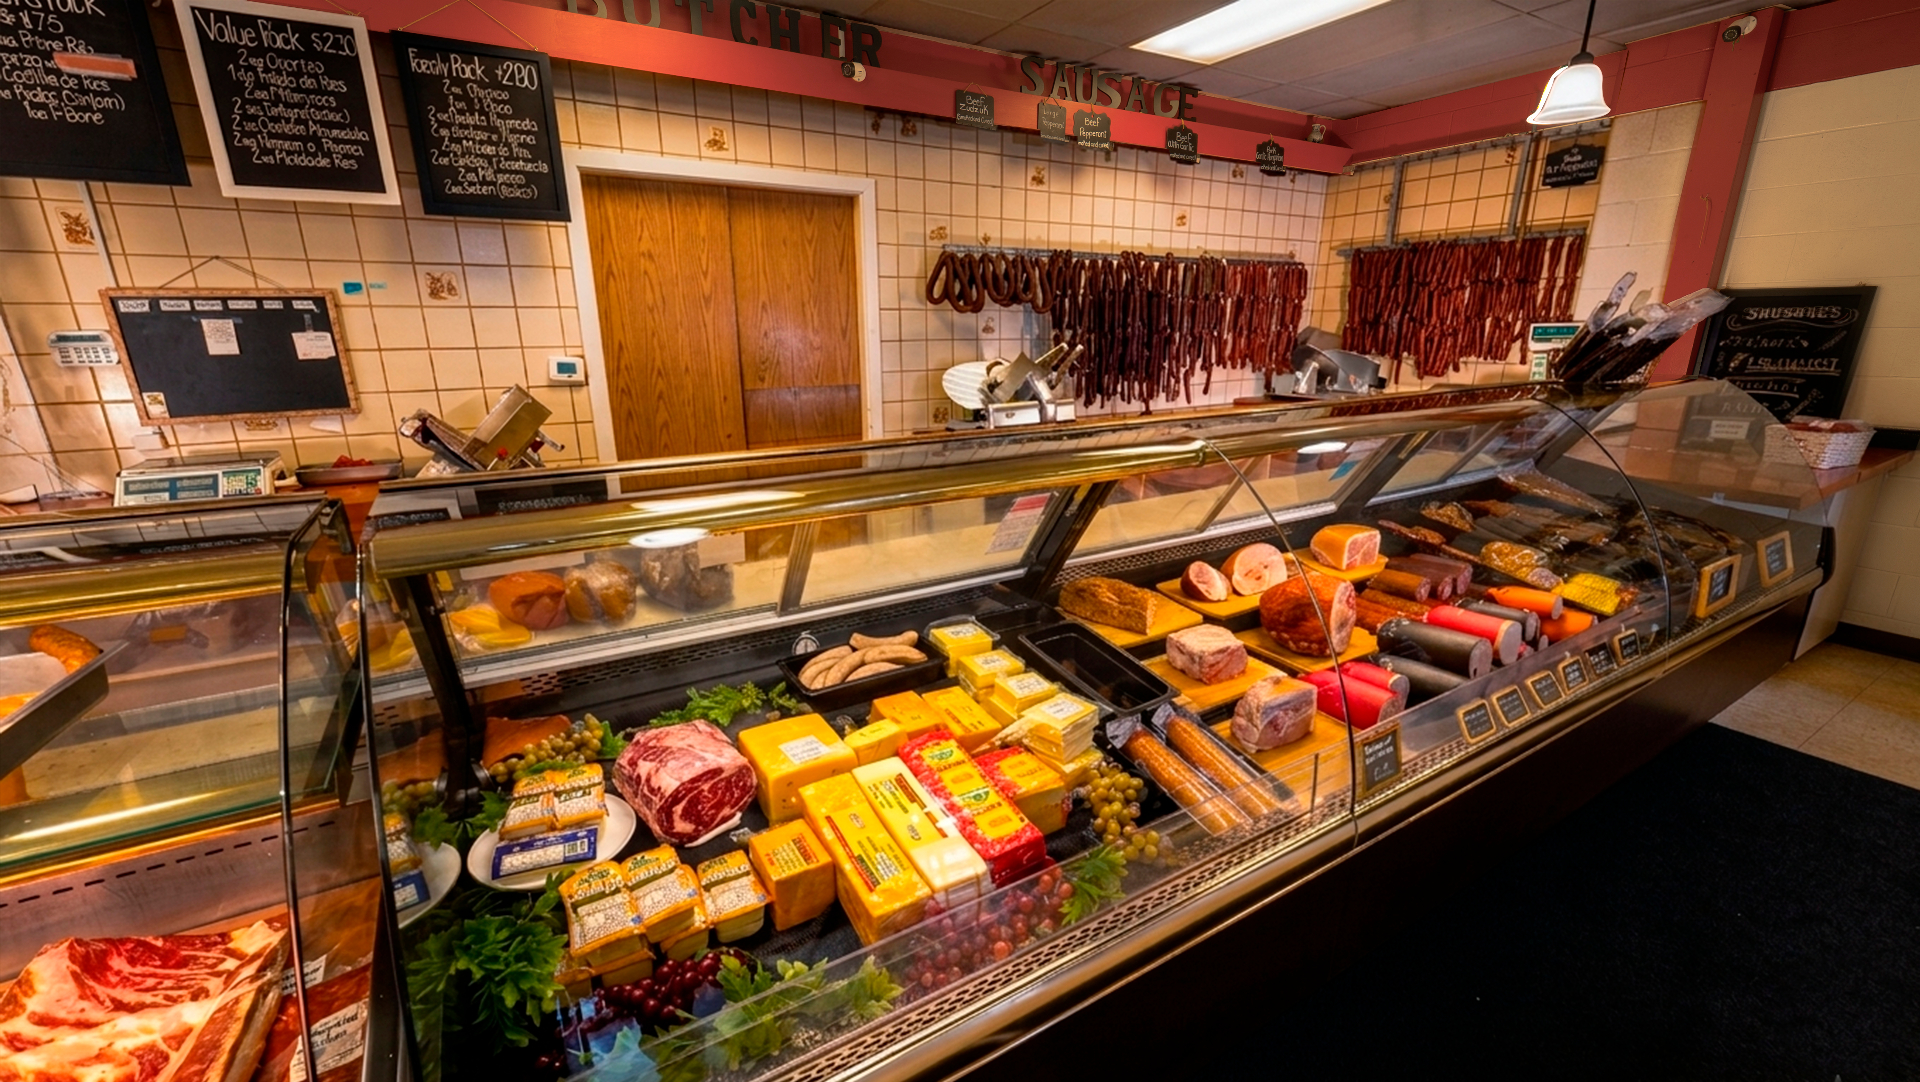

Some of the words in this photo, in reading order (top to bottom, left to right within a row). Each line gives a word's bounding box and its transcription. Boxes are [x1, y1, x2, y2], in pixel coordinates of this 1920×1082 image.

[194, 9, 258, 48] Value
[257, 19, 305, 51] Pack
[450, 54, 490, 82] Pack
[1020, 56, 1200, 122] SAUSAGE
[965, 95, 986, 107] Beef
[1084, 117, 1101, 127] Beef
[1079, 127, 1107, 139] Pepperoni
